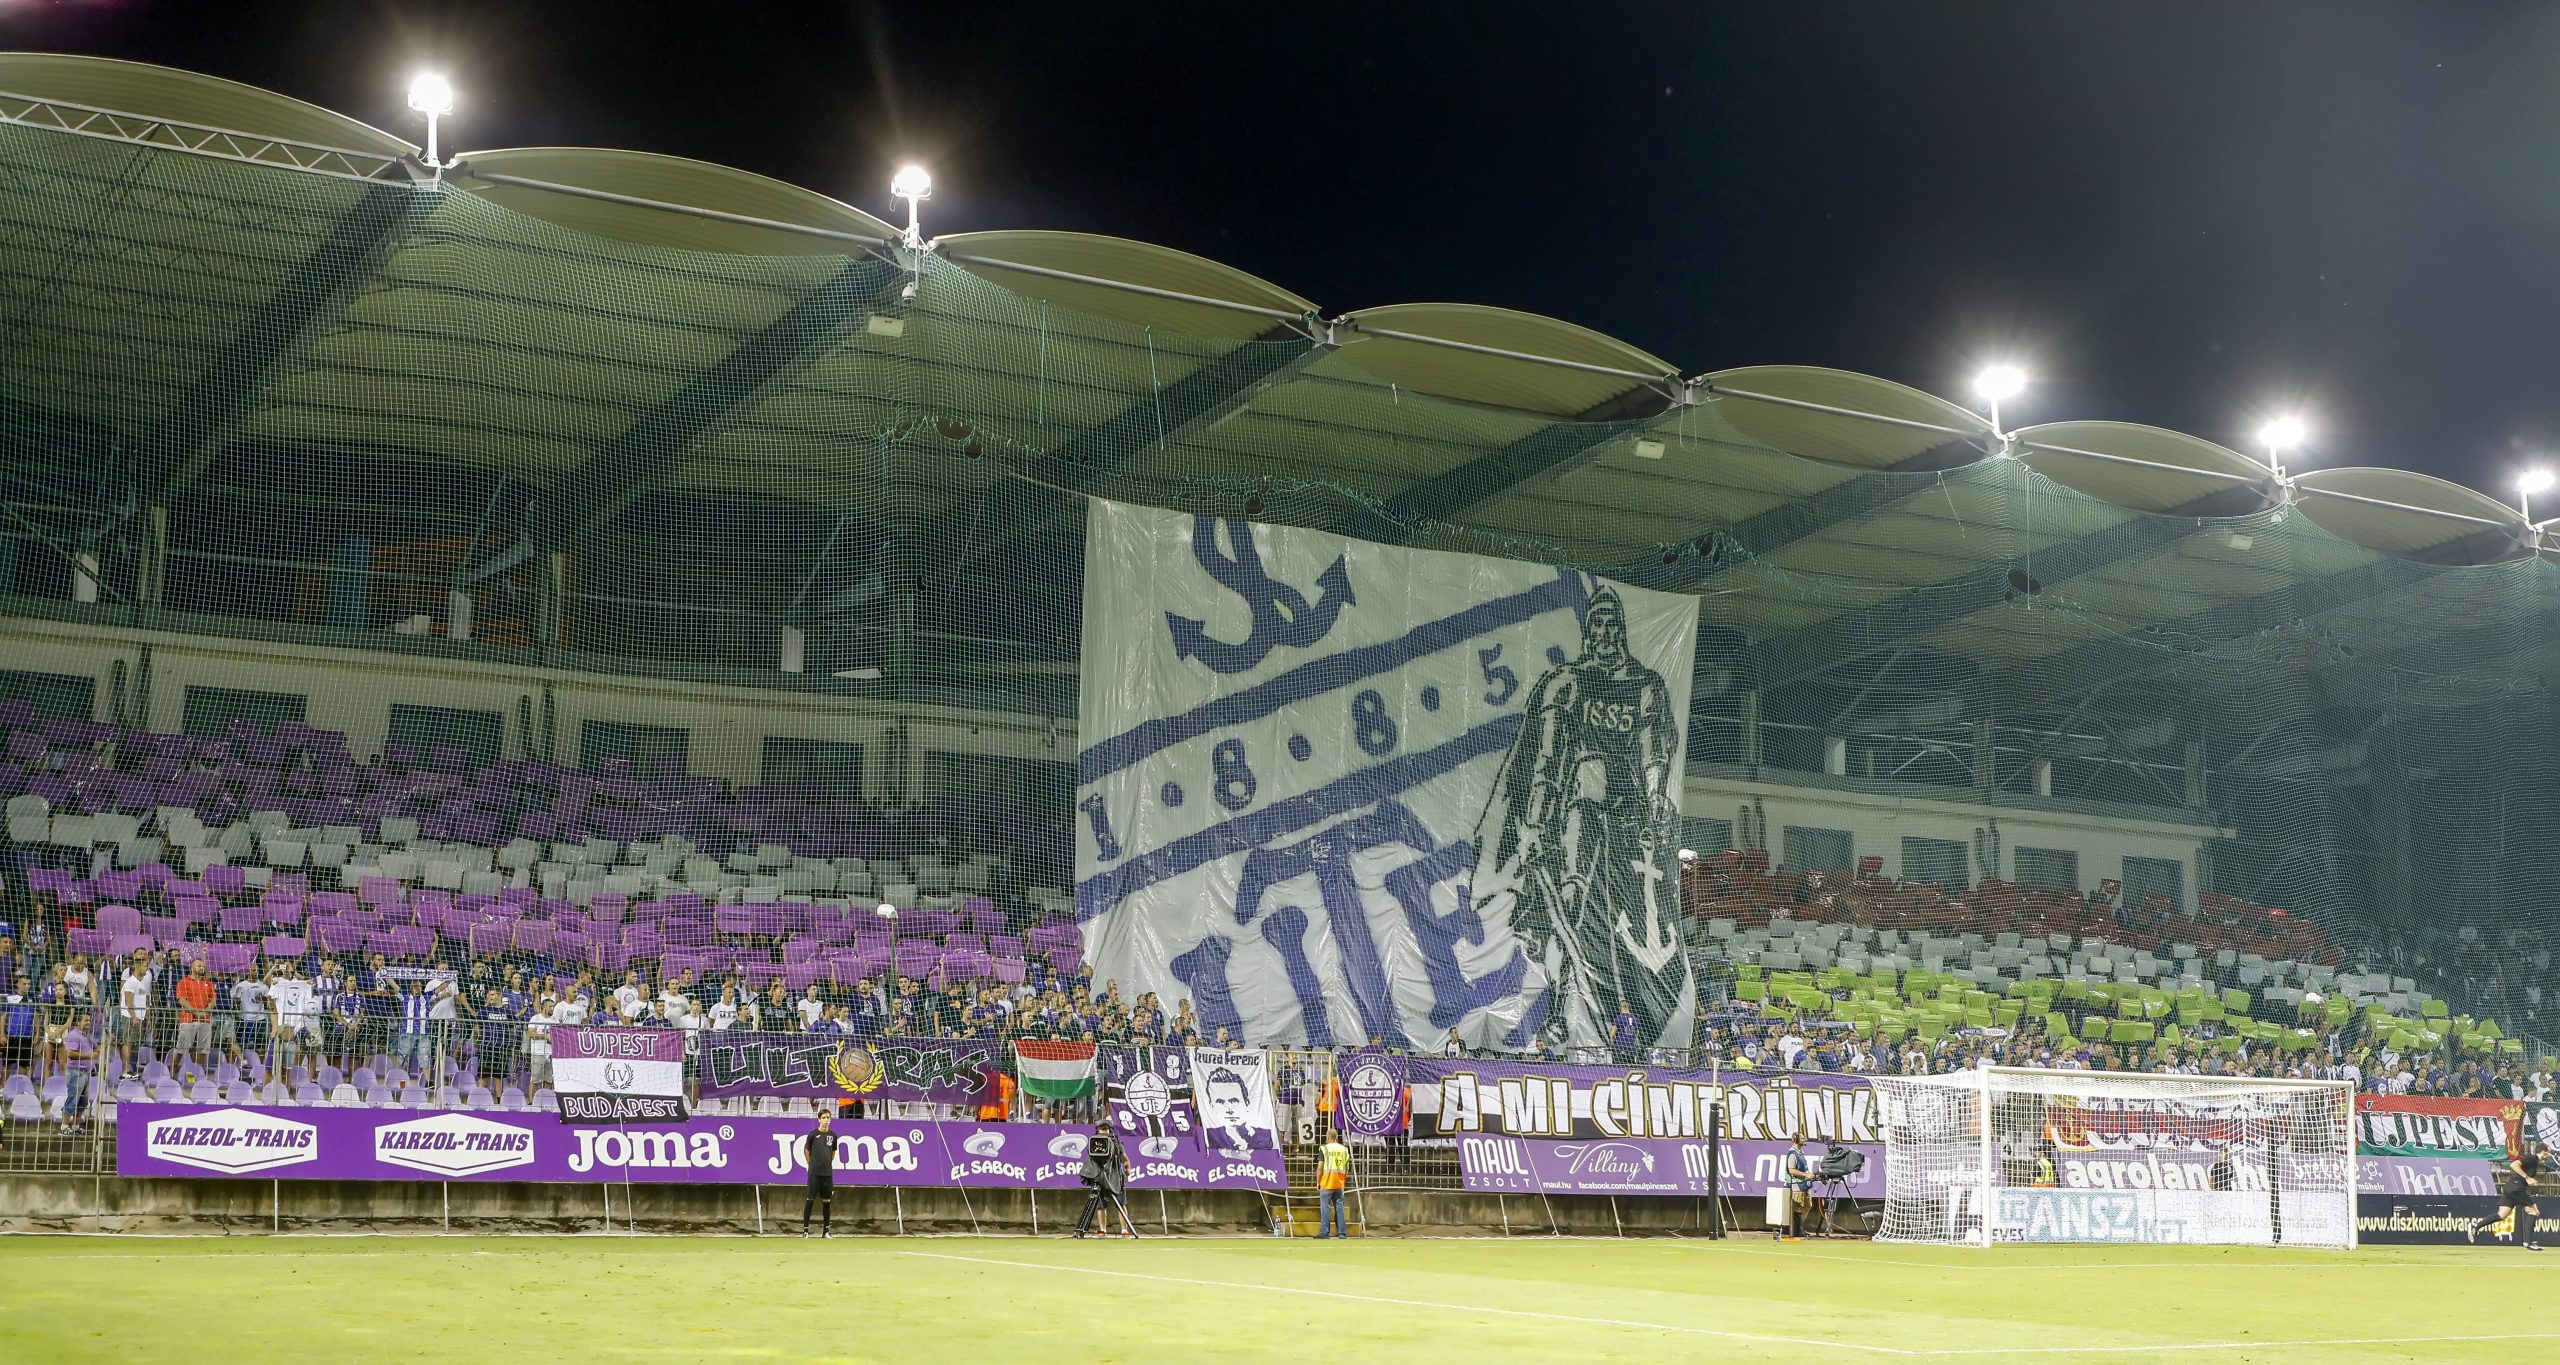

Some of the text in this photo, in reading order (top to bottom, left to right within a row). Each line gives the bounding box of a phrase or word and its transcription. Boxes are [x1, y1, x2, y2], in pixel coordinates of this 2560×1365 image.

[578, 1026, 659, 1057] ÚJPEST
[611, 1069, 628, 1083] IV
[563, 1096, 678, 1118] BUDAPEST
[1437, 1071, 1482, 1134] A
[1498, 1074, 1573, 1136] MI
[1301, 1123, 1315, 1141] 3
[2357, 1101, 2500, 1151] ÚJPEST
[152, 1126, 313, 1148] KARZOL-TRANS
[380, 1131, 530, 1152] KARZOL-TRANS
[1463, 1137, 1529, 1175] MAUL
[1554, 1142, 1642, 1182] Villány
[951, 1163, 969, 1181] EL
[1036, 1164, 1054, 1181] EL
[1128, 1165, 1145, 1182] EL
[1208, 1165, 1225, 1183] EL
[1469, 1177, 1530, 1188] ZSOLT
[1543, 1181, 1572, 1189] maul.hu
